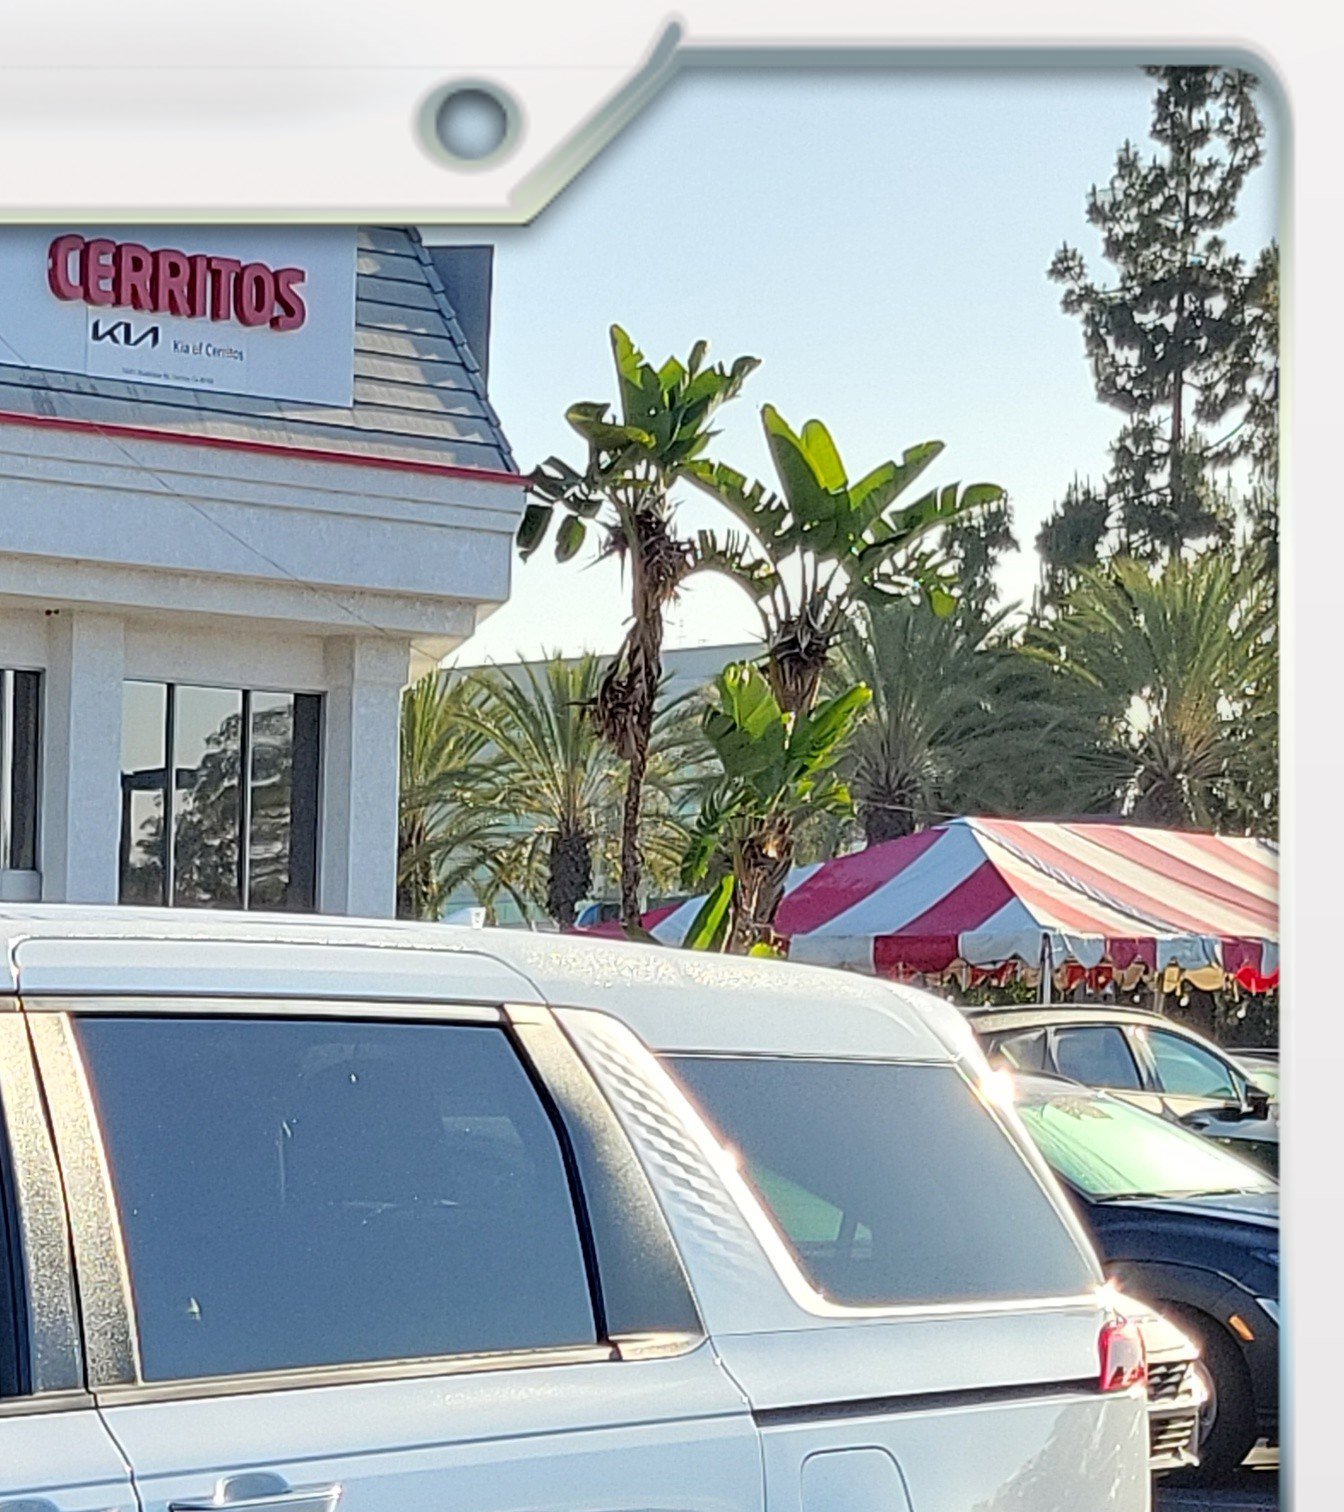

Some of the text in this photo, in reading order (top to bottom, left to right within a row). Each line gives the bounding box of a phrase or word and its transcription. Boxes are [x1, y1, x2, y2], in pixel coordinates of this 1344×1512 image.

[47, 233, 307, 332] CERRITOS
[91, 318, 160, 349] KIA
[173, 340, 190, 355] Kia
